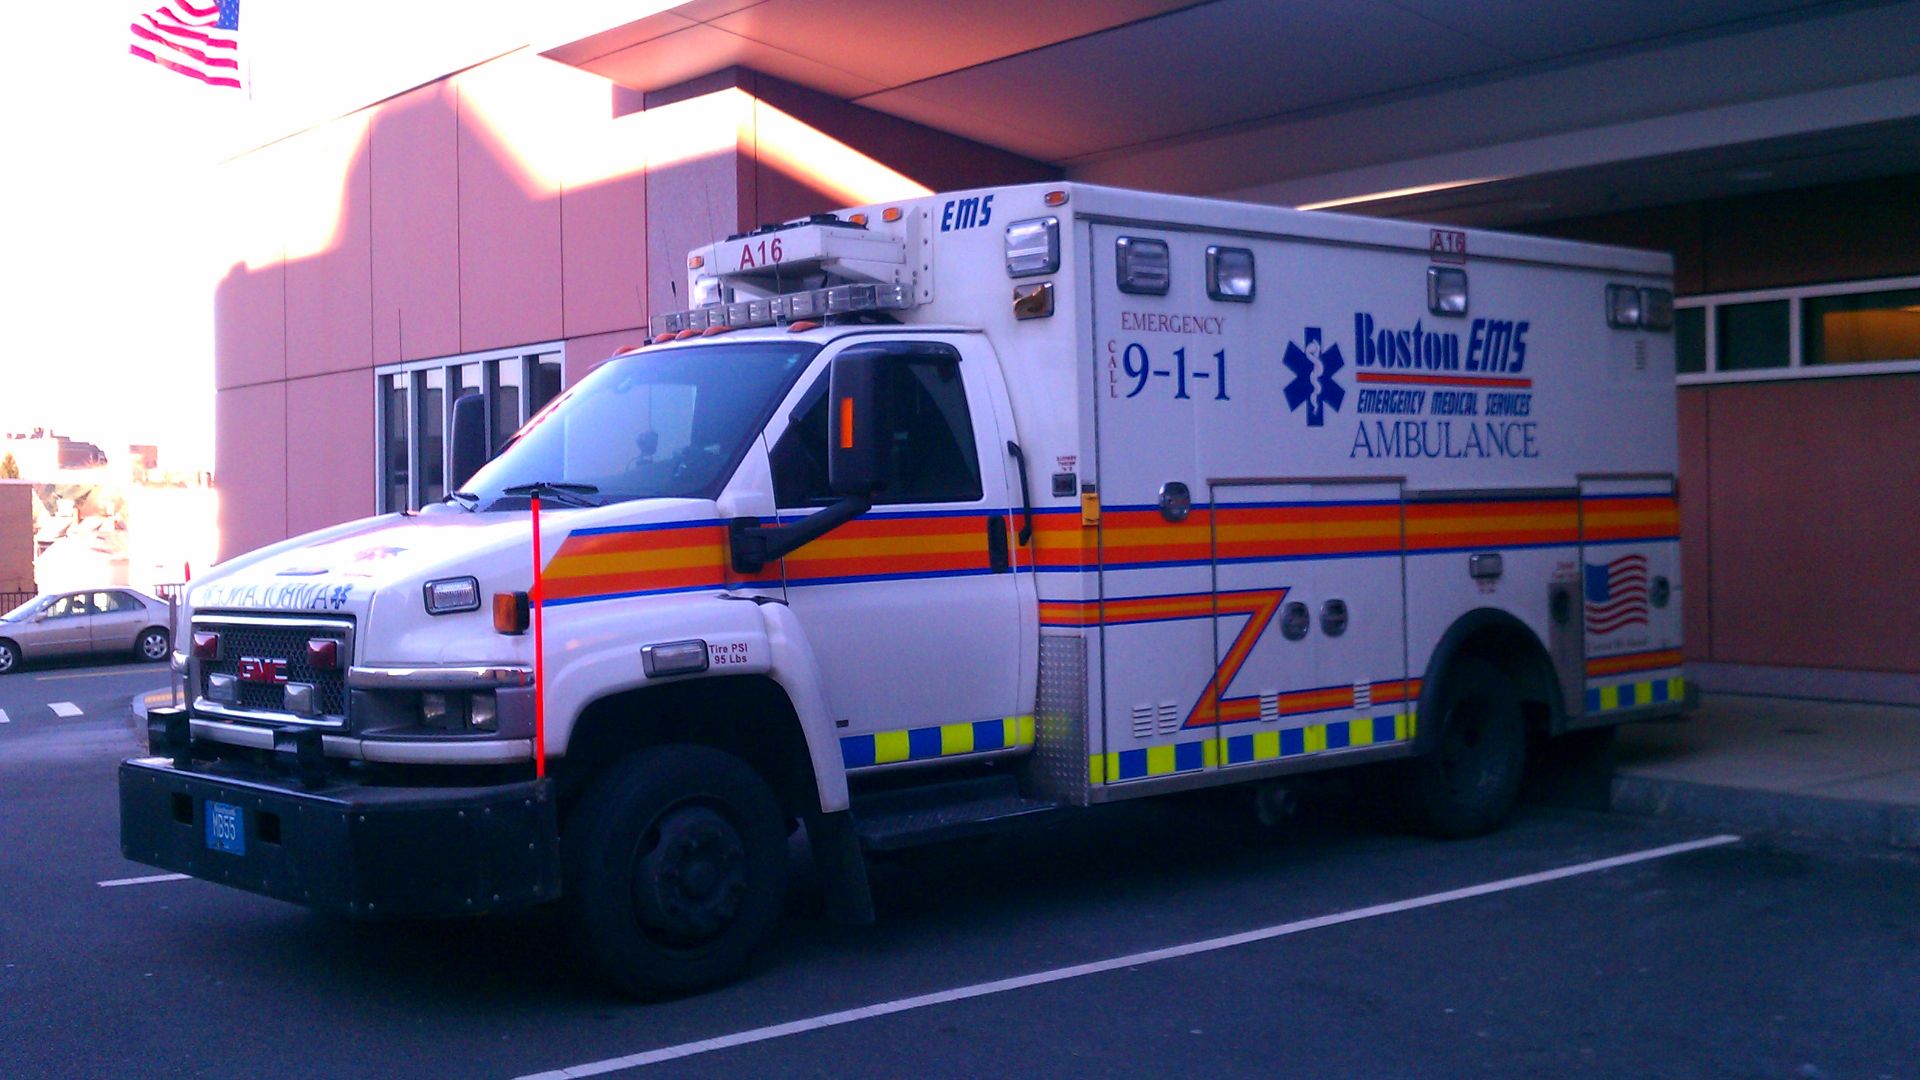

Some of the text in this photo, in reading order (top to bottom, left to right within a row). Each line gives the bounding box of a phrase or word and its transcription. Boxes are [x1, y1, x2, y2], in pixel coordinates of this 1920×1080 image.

[941, 194, 995, 232] EMS
[740, 238, 783, 270] A16
[1432, 231, 1464, 255] A16
[1121, 312, 1224, 335] EMERGENCY
[1355, 312, 1529, 373] Boston EMS
[1108, 340, 1118, 399] CALL
[1122, 342, 1230, 401] 9-1-1
[1357, 389, 1532, 417] EMERGENCY MEDICAL SERVICES
[1349, 420, 1540, 459] AMBULANCE
[709, 643, 748, 654] Tire PSI
[714, 654, 748, 665] 95 Lbs
[239, 657, 288, 684] GMC
